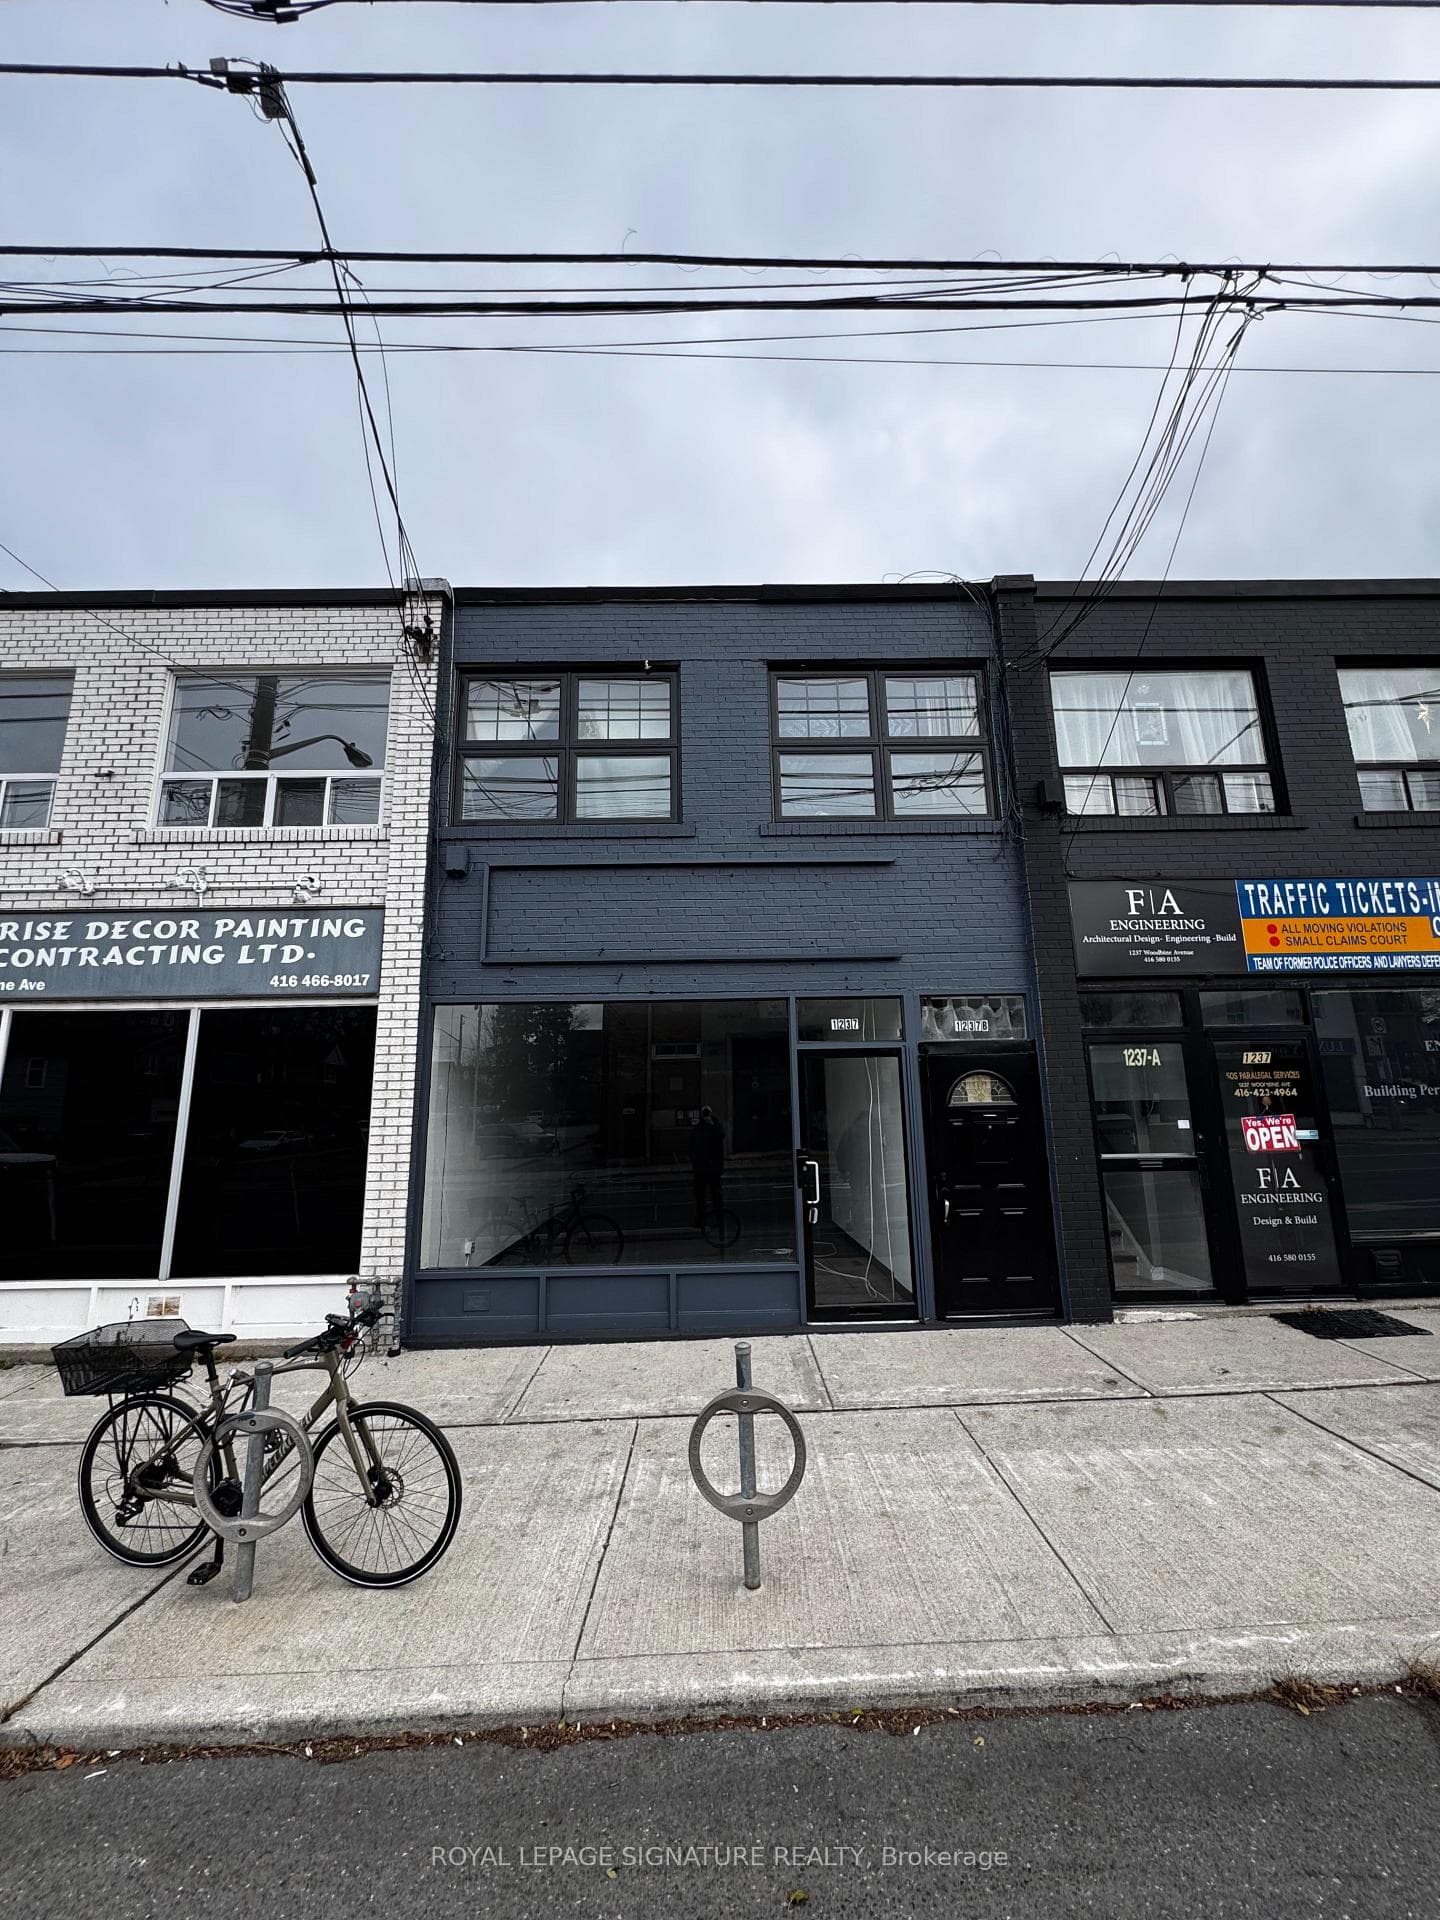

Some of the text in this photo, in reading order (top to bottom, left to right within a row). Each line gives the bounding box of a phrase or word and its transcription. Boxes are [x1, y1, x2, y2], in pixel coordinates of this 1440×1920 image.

[1244, 882, 1330, 915] TRAFFIC
[0, 919, 366, 941] RISE DECOR PAINTING
[1110, 919, 1205, 931] ENGINEERING
[1281, 922, 1407, 934] ALL MOVING VIOLATIONS
[1083, 935, 1132, 943] Architectural
[1165, 934, 1211, 944] Engineering
[1285, 935, 1408, 946] SMALL CLAIMS COURT
[1253, 954, 1440, 970] TEAM OF FORMER POLICE OFFICERS AND LAWYERS DEFE
[19, 979, 46, 991] Ave
[269, 974, 370, 988] 416 466-8017
[832, 1019, 858, 1029] 1237
[1123, 1049, 1161, 1066] 1237-A
[1244, 1053, 1271, 1063] 1237
[1364, 1085, 1417, 1098] Building
[1266, 1117, 1292, 1125] We're
[1246, 1125, 1298, 1151] OPEN
[1241, 1192, 1323, 1204] ENGINEERING
[1253, 1215, 1317, 1227] Design & Build
[1268, 1254, 1281, 1262] 416
[1298, 1253, 1316, 1261] 0155
